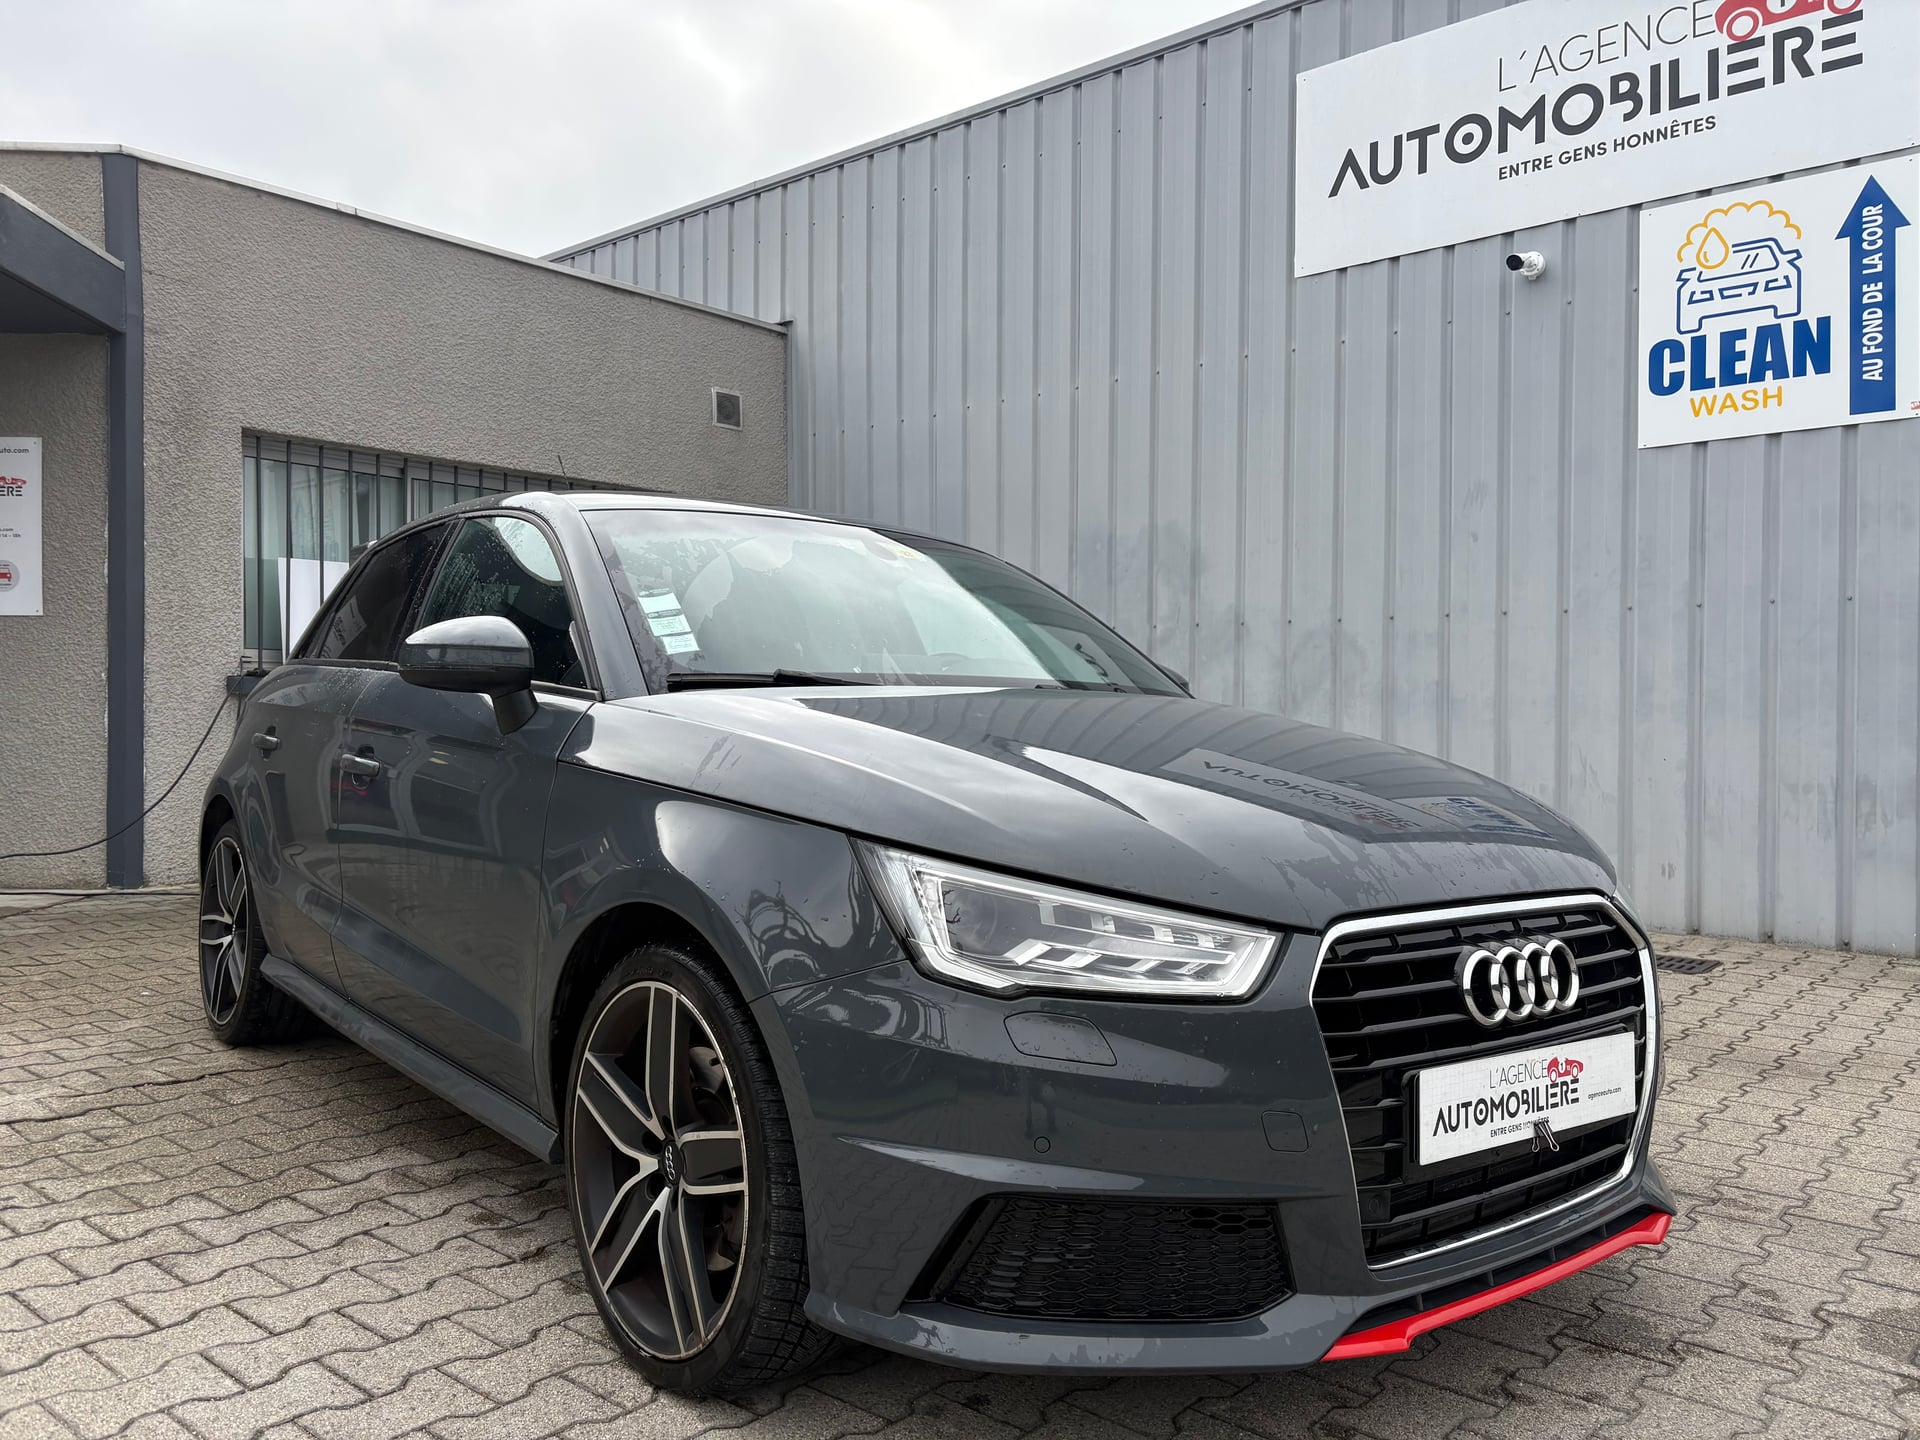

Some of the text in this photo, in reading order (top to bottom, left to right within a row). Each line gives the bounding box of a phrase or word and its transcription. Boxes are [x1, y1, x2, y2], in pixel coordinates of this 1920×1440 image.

[1498, 115, 1717, 180] ENTRE GENS HONNÊTES
[1862, 203, 1883, 381] AU FOND DE LA COUR
[1648, 315, 1831, 397] CLEAN
[1689, 385, 1783, 418] WASH
[1489, 1058, 1548, 1089] L'AGENCE
[1587, 1087, 1622, 1101] agenceauto.com
[1490, 1126, 1507, 1138] ENTRE
[1507, 1122, 1523, 1134] GENS
